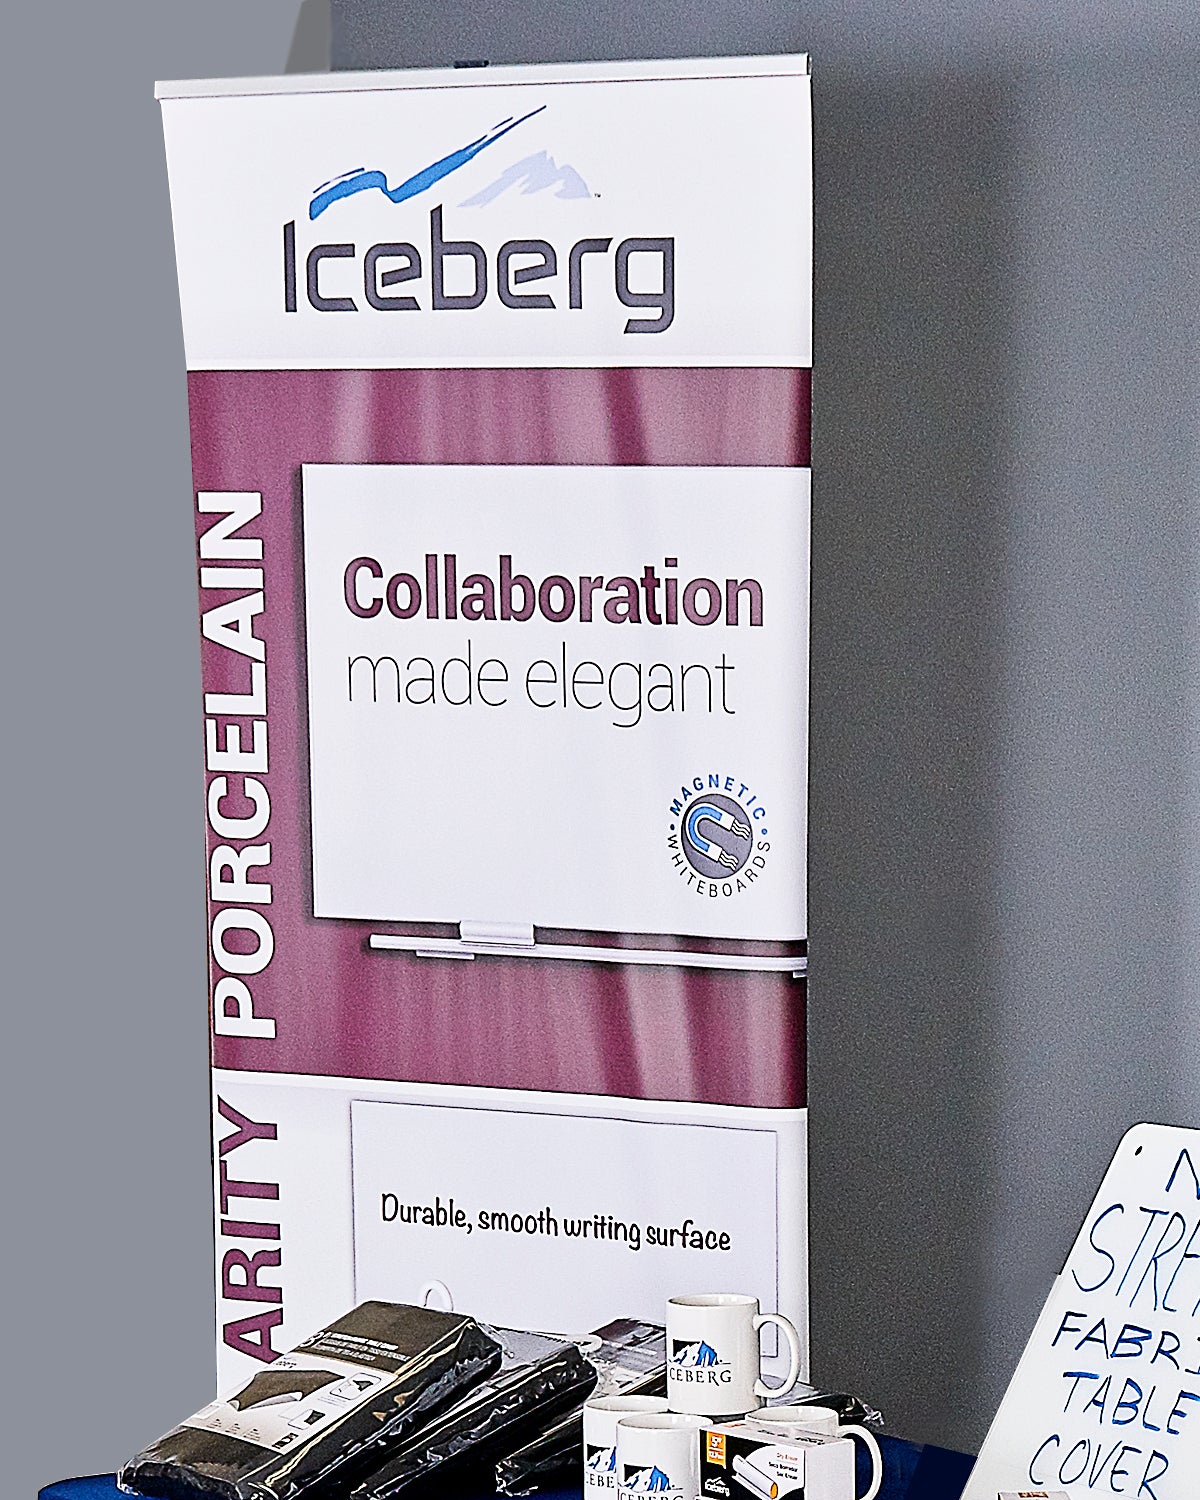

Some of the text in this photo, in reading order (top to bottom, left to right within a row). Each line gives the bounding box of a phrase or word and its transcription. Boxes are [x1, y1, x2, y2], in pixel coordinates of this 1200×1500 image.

[283, 203, 675, 334] Iceberg
[343, 553, 764, 627] Collaboration
[348, 639, 736, 729] made elegant
[197, 490, 277, 1039] PORCELAIN
[669, 774, 766, 820] MAGNETIC
[667, 833, 771, 898] WHITEBOARDS
[381, 1193, 731, 1252] Durable, smooth writing surface
